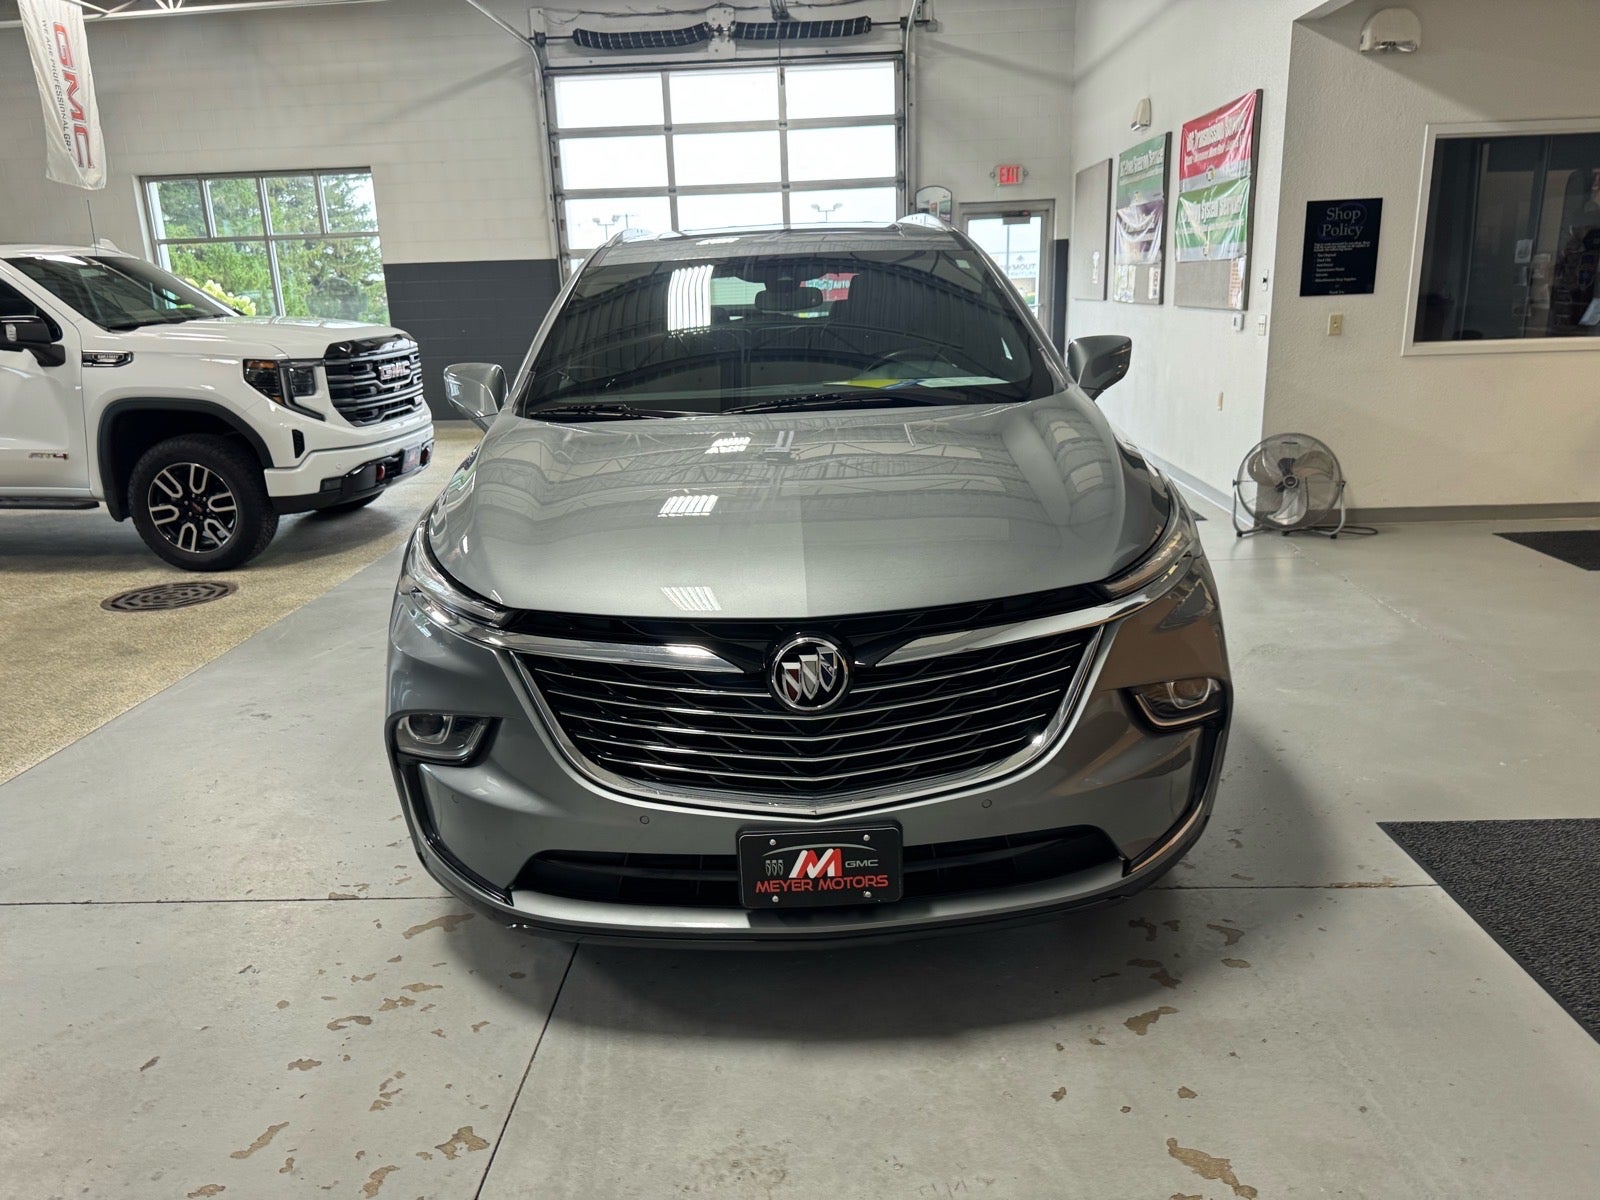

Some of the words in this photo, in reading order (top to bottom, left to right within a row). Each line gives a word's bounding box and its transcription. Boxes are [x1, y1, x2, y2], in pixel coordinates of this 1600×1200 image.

[50, 58, 69, 131] PROFESSIONAL
[53, 22, 95, 169] GMC
[999, 166, 1020, 183] EXIT
[1326, 207, 1361, 224] Shop
[1322, 223, 1363, 239] Policy
[379, 360, 411, 380] GMC
[845, 859, 879, 868] GMC
[755, 879, 813, 893] MEYER
[818, 875, 889, 891] MOTORS
